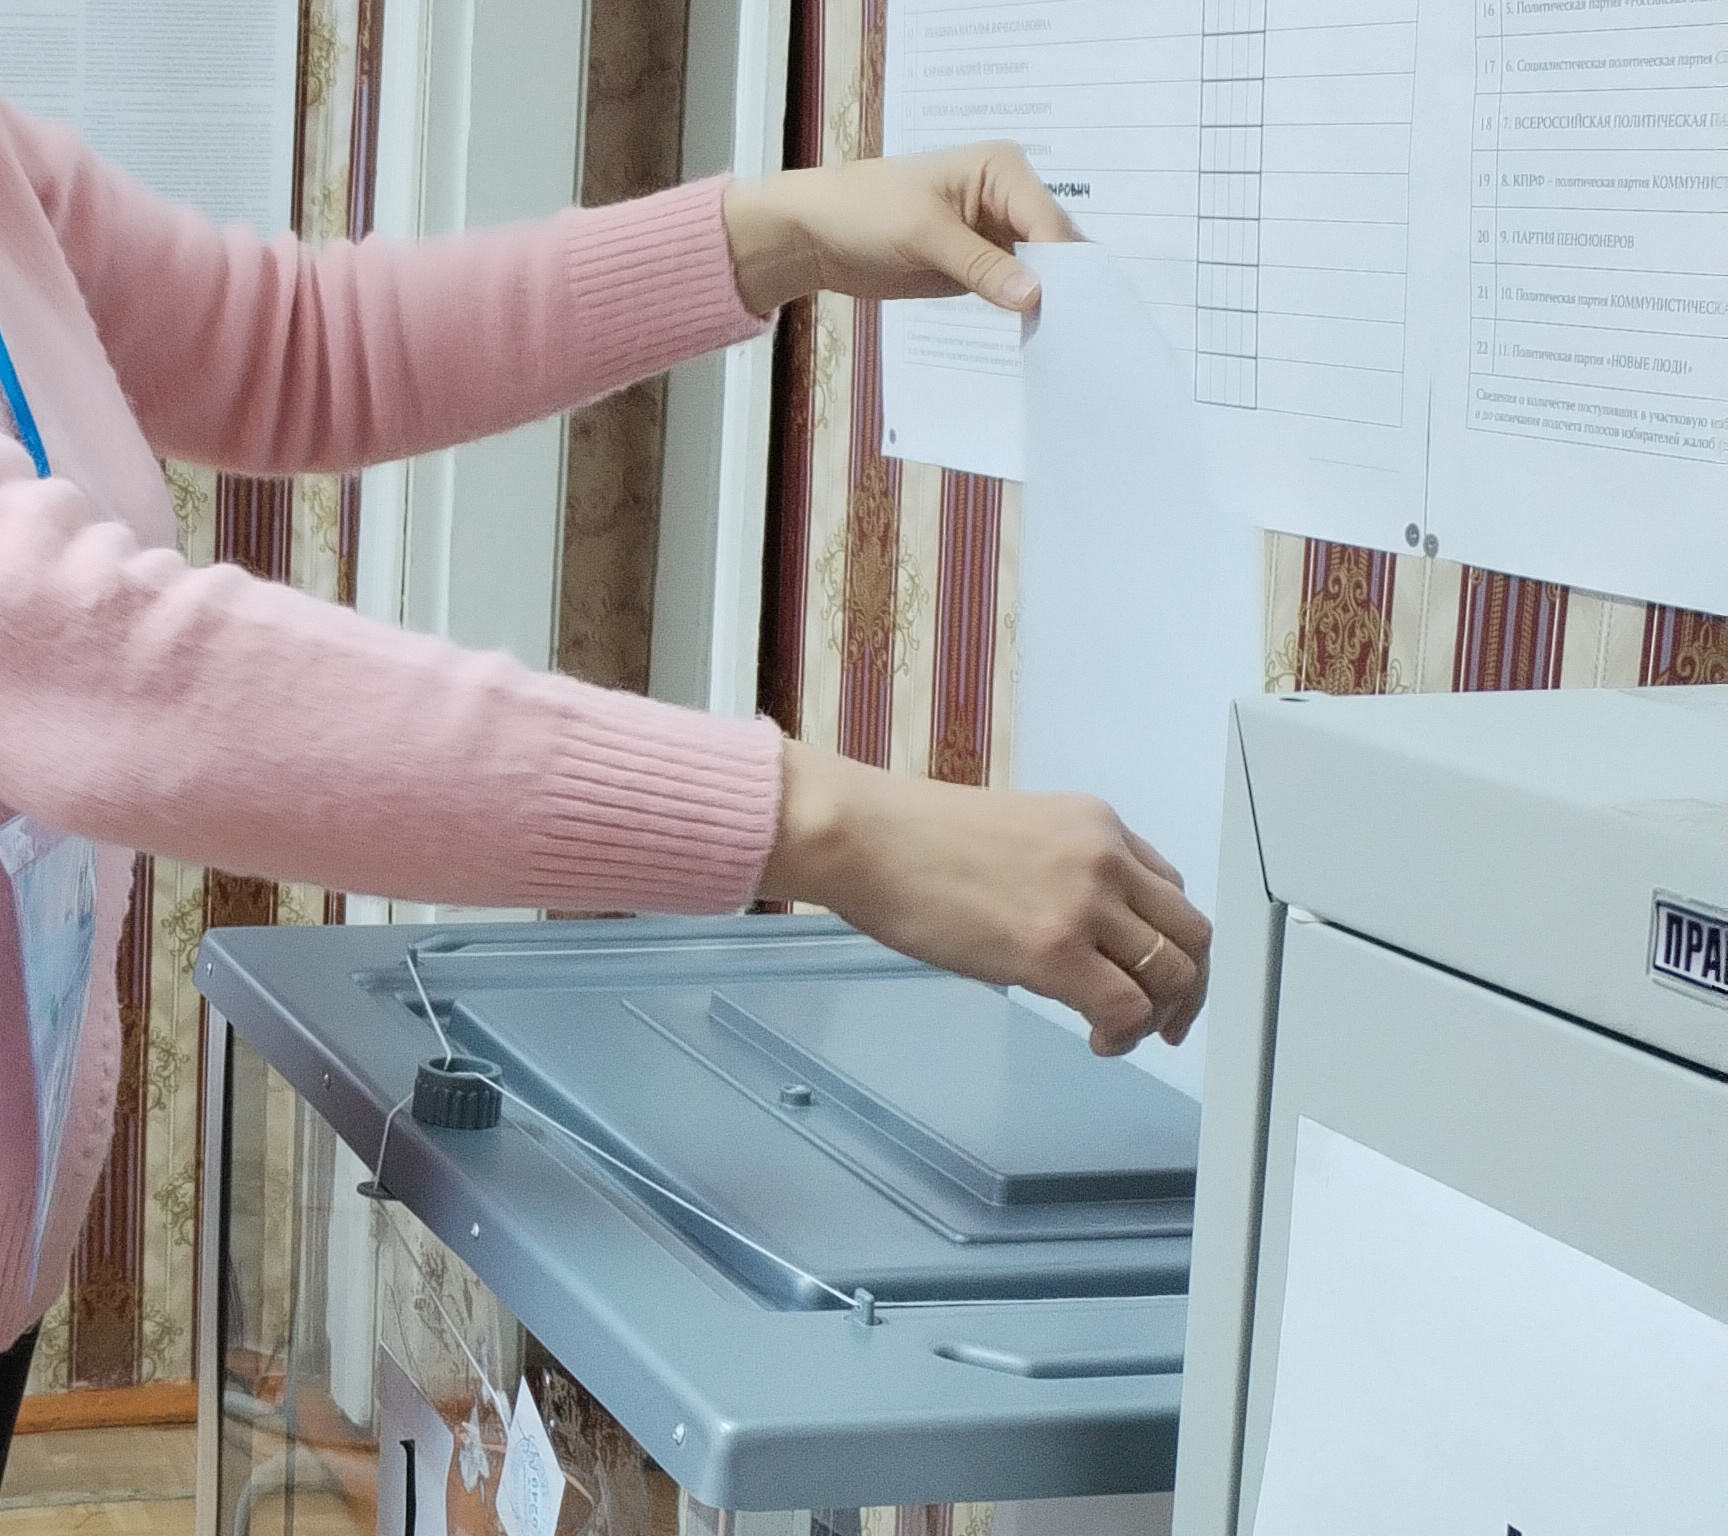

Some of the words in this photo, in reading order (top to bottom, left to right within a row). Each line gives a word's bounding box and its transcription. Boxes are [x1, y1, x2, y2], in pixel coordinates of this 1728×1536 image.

[1483, 3, 1495, 17] 16
[1484, 60, 1495, 74] 17
[1517, 57, 1606, 72] Социалистическая
[1608, 55, 1675, 69] политическая
[1677, 54, 1712, 69] партия
[1481, 117, 1492, 131] 18
[1514, 113, 1610, 130] ВСЕРОССИЙСКАЯ
[1614, 113, 1707, 129] ПОЛИТИЧЕСКАЯ
[1478, 174, 1490, 187] 19
[1513, 174, 1545, 188] КПРФ
[1554, 178, 1614, 188] политическая
[1617, 179, 1649, 192] партия
[1477, 230, 1489, 243] 20
[1512, 230, 1554, 245] ПАРТИЯ
[1557, 232, 1634, 249] ПЕНСИОНЕРОВ
[1477, 285, 1489, 299] 21
[1500, 287, 1514, 301] 10.
[1516, 288, 1576, 304] Политическая
[1578, 296, 1608, 310] партия
[1477, 342, 1488, 355] 22
[1499, 343, 1510, 357] 11.
[1512, 345, 1572, 362] Политическая
[1574, 352, 1604, 366] партия
[1607, 354, 1649, 371] «НОВЫЕ
[1652, 356, 1693, 376] ЛЮДИ»
[1476, 388, 1517, 405] Сведения
[1527, 396, 1576, 412] количестве
[1578, 402, 1638, 421] поступивших
[1648, 410, 1708, 430] участковую
[1482, 411, 1492, 422] до
[1494, 411, 1540, 428] окончания
[1542, 416, 1581, 433] подсчета
[1584, 423, 1619, 438] голосов
[1622, 426, 1680, 446] избирателей
[1682, 436, 1716, 450] жалоб
[1664, 912, 1728, 985] ПРА
